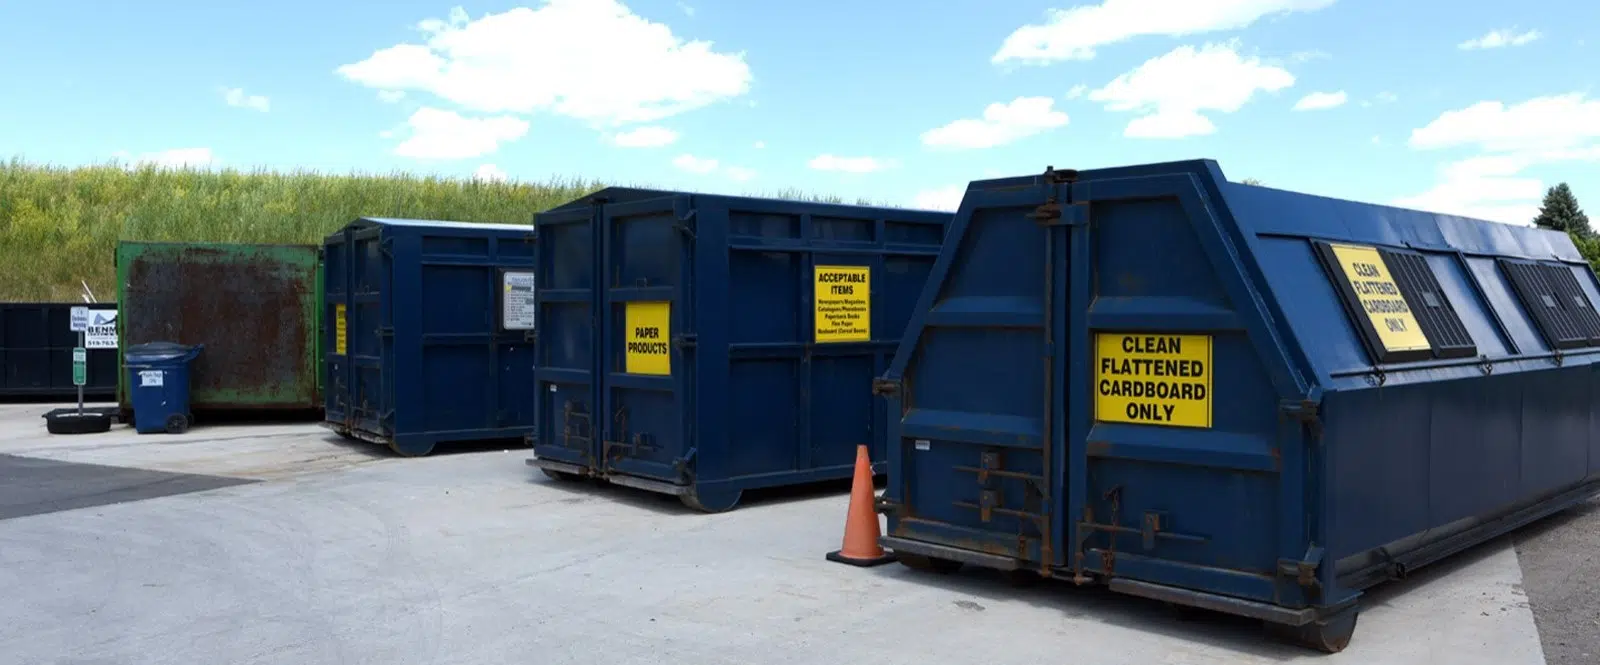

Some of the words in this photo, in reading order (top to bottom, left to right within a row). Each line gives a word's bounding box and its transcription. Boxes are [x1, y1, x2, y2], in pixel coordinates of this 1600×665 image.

[1352, 262, 1380, 277] CLEAN
[818, 272, 866, 283] ACCEPTABLE
[831, 285, 854, 295] ITEMS
[1353, 280, 1398, 295] FLATTENED
[1363, 299, 1408, 314] CARDBOARD
[1384, 318, 1408, 332] ONLY
[635, 327, 659, 339] PAPER
[628, 342, 667, 355] PRODUCTS
[1122, 336, 1181, 354] CLEAN
[1101, 358, 1204, 377] FLATTENED
[1100, 379, 1206, 400] CARDBOARD
[1126, 402, 1175, 421] ONLY
